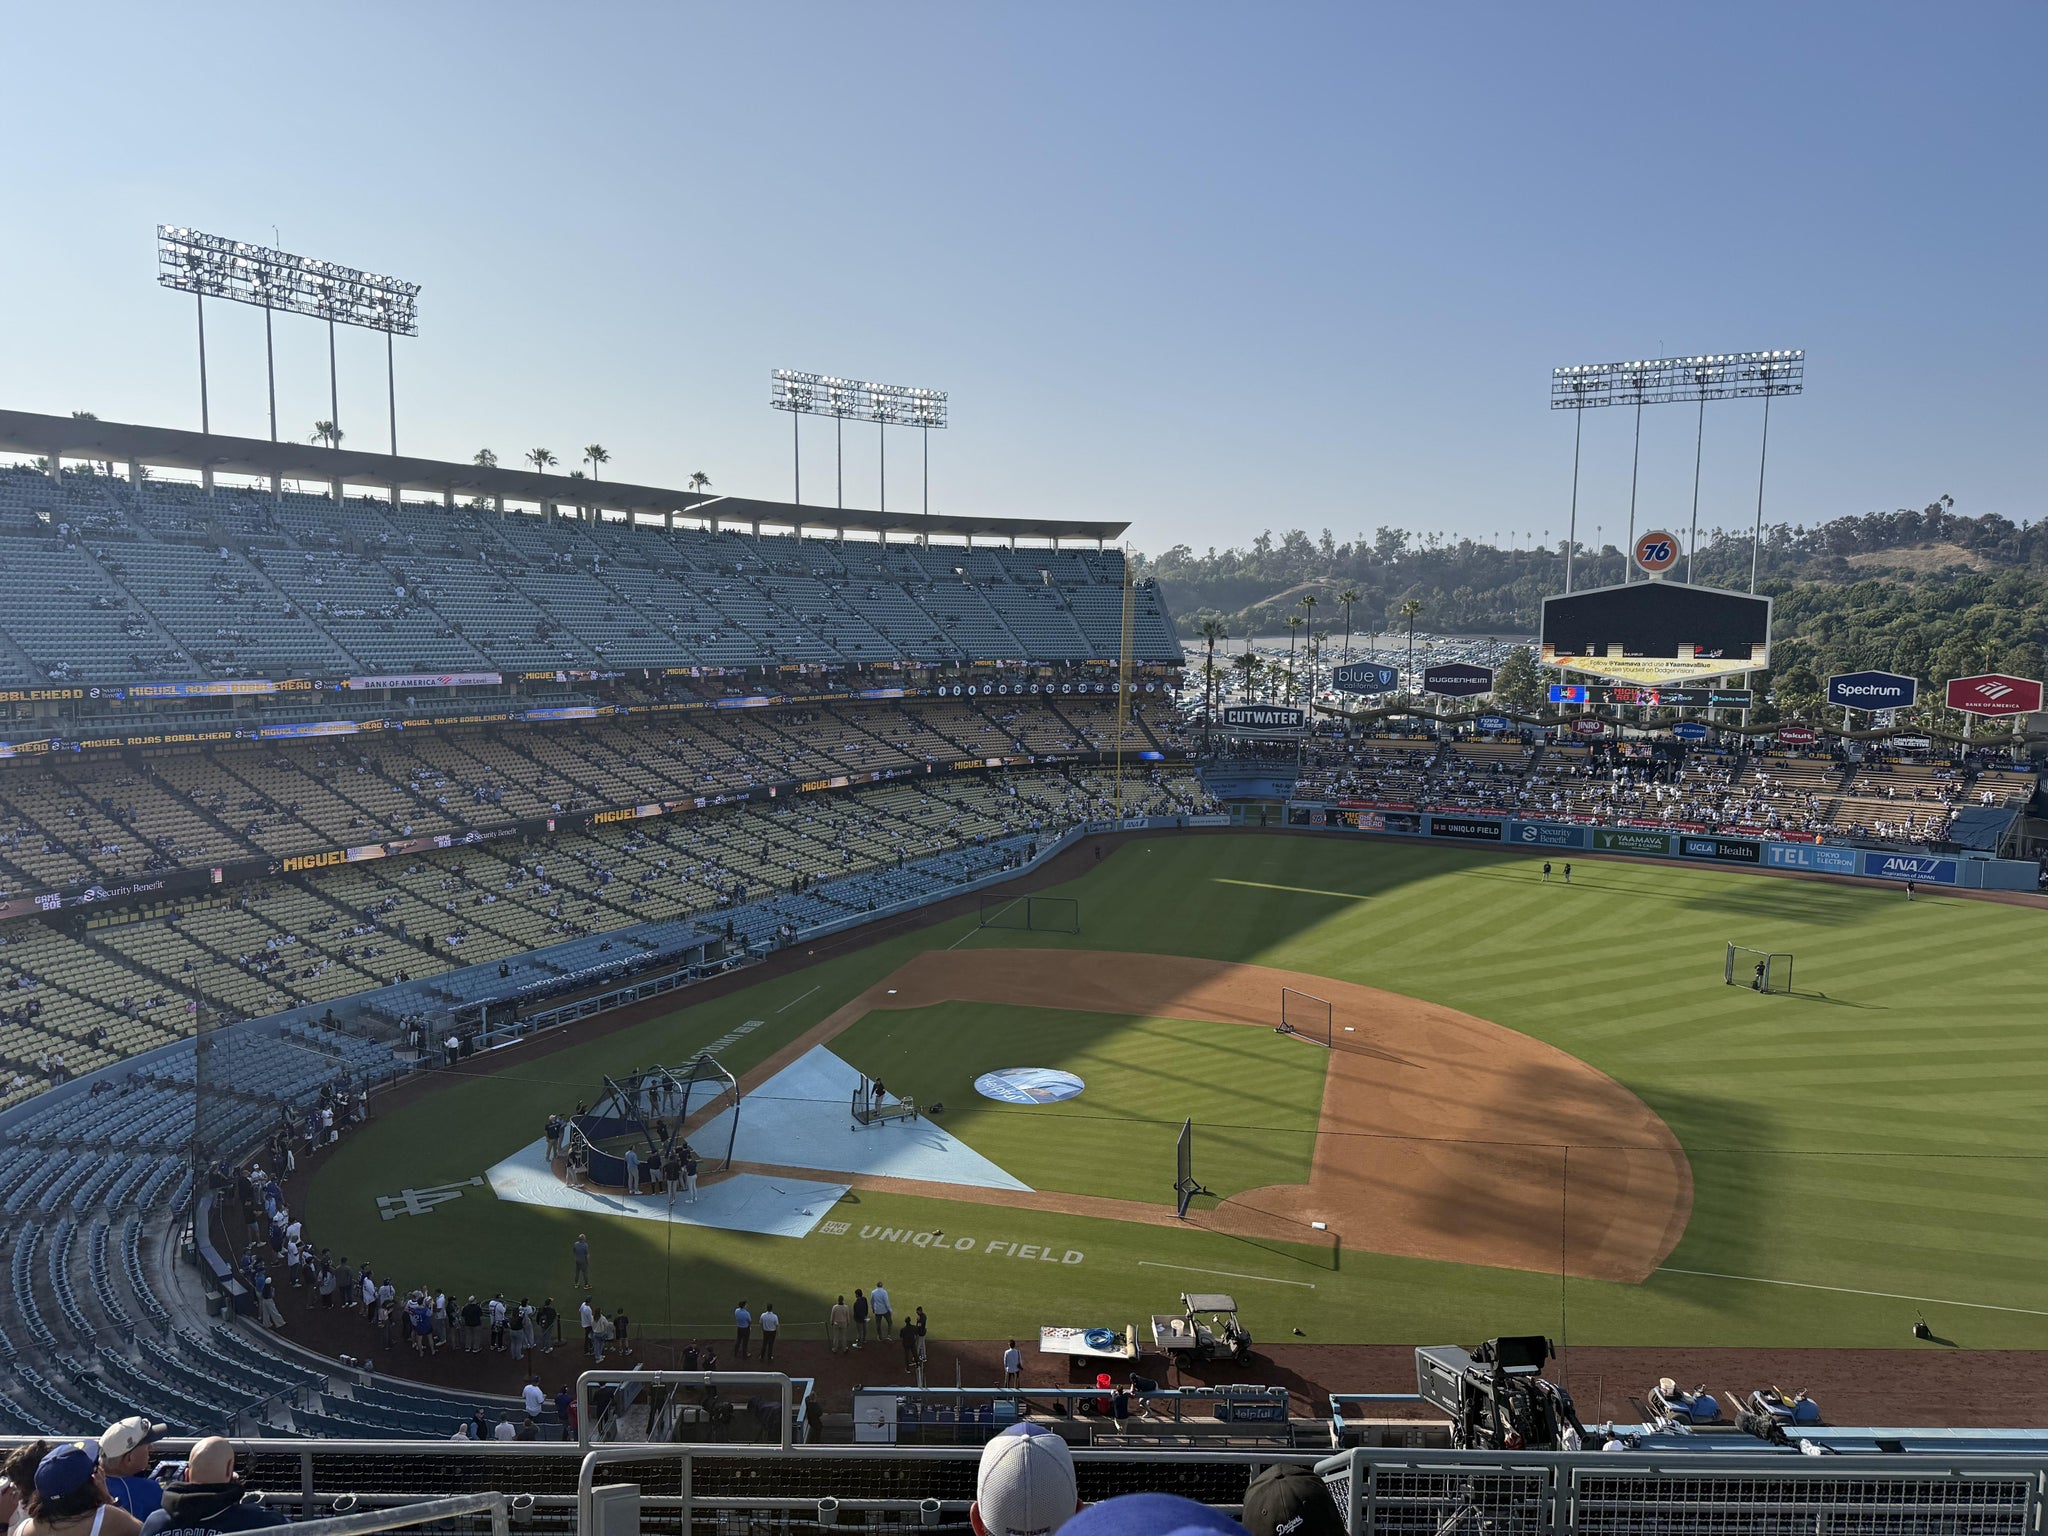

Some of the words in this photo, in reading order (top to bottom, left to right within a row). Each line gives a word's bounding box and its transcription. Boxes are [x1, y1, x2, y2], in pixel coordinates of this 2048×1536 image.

[1642, 541, 1671, 563] 76
[1609, 660, 1641, 668] @Yaamava
[526, 671, 556, 680] MIGUEL
[1339, 668, 1374, 683] blue
[402, 678, 436, 687] AMERICA
[129, 686, 181, 697] MIGUEL
[1837, 684, 1901, 697] Spectrum
[403, 719, 432, 727] MIGUEL
[1229, 711, 1297, 724] CUTWATER
[1578, 722, 1600, 730] JINRO
[260, 728, 294, 737] MIGUEL
[1782, 732, 1812, 740] Yakult
[83, 739, 124, 748] MIGUEL
[128, 736, 161, 745] ROJAS
[165, 731, 231, 742] BOBBLEHEAD
[954, 760, 985, 770] MIGUEL
[802, 779, 832, 792] MIGUEL
[594, 808, 637, 824] MIGUEL
[1312, 816, 1322, 824] 76
[473, 830, 497, 843] Security
[498, 827, 518, 837] Benefit
[1449, 824, 1475, 834] UNIQLO
[1477, 826, 1499, 835] FIELD
[1540, 826, 1572, 838] Security
[1540, 835, 1568, 845] Benefit
[1617, 834, 1662, 845] YAAMAVA
[1690, 843, 1713, 852] UCLA
[1719, 845, 1753, 857] Health
[283, 849, 348, 873] MIGUEL
[1771, 847, 1809, 865] TEL
[1817, 857, 1853, 868] ELECTRON
[1883, 858, 1918, 871] ANA
[1882, 870, 1910, 879] Inspiration
[97, 885, 131, 898] Security
[133, 880, 164, 893] Benefit
[35, 893, 61, 904] GAME
[822, 1227, 844, 1235] QLO
[859, 1225, 976, 1255] UNIQLO
[985, 1241, 1084, 1265] FIELD
[1276, 1515, 1303, 1536] Dodgers
